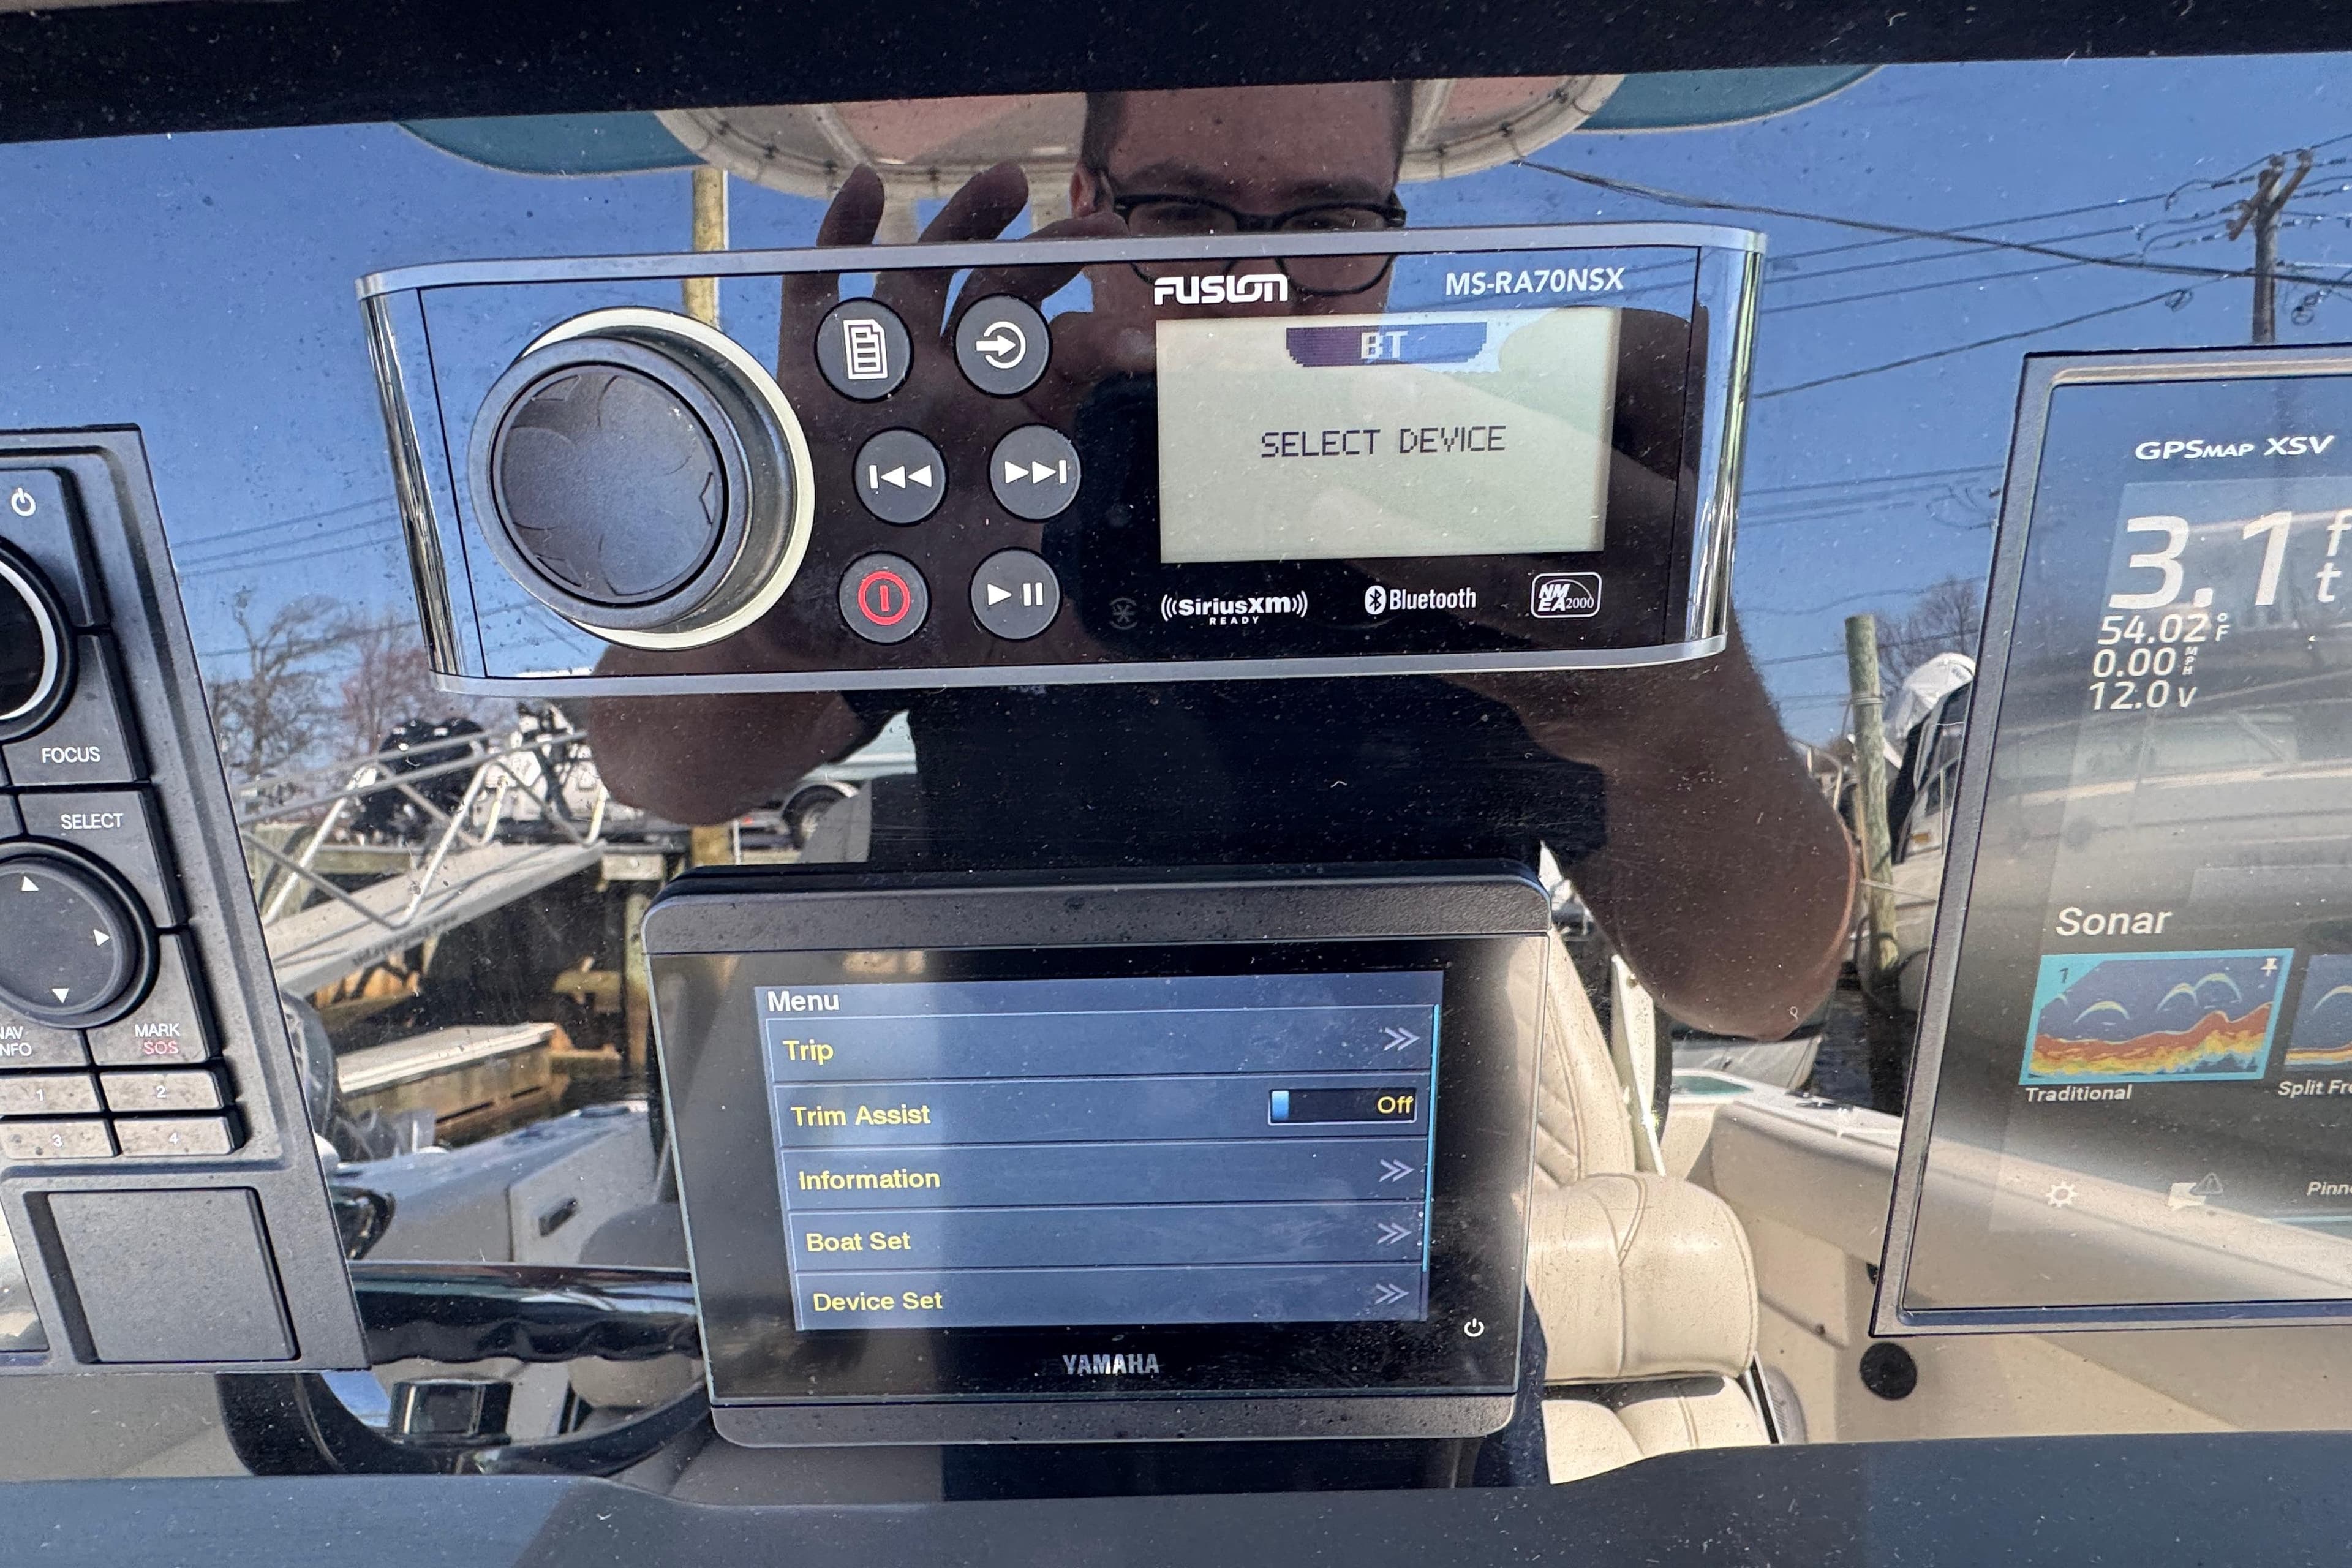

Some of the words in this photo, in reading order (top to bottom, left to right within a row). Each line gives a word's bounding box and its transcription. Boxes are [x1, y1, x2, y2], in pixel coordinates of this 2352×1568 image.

[1154, 274, 1288, 306] FUSION
[1446, 266, 1625, 297] MS-RA70NSX
[1360, 331, 1408, 360] BT
[1261, 429, 1380, 458] SELECT
[1400, 425, 1507, 454] DEVICE
[2264, 435, 2334, 456] XSV
[2108, 511, 2292, 609] 3.1
[1389, 587, 1476, 612] Bluetooth
[1566, 597, 1594, 609] 2000
[1209, 616, 1259, 625] READY
[2097, 612, 2209, 645] 54.02
[2093, 646, 2176, 677] 0.00
[2089, 680, 2170, 710] 12.0
[42, 746, 100, 763] FOCUS
[61, 813, 124, 829] SELECT
[2056, 907, 2173, 937] Sonar
[2059, 968, 2068, 984] 1
[767, 991, 840, 1012] Menu
[134, 1023, 180, 1037] MARK
[143, 1041, 178, 1055] SOS
[783, 1040, 834, 1065] Trip
[36, 1088, 44, 1101] 1
[156, 1085, 167, 1099] 2
[2026, 1084, 2133, 1102] Traditional
[2278, 1079, 2324, 1098] Split
[791, 1106, 846, 1126] Trim
[855, 1104, 931, 1125] Assist
[1377, 1095, 1414, 1114] Off
[52, 1134, 63, 1148] 3
[168, 1132, 179, 1145] 4
[799, 1169, 940, 1190] Information
[2306, 1181, 2352, 1196] Pinn
[807, 1232, 862, 1252] Boat
[869, 1231, 911, 1250] Set
[813, 1292, 894, 1311] Device
[903, 1291, 943, 1310] Set
[1062, 1353, 1159, 1376] YAMAHA
